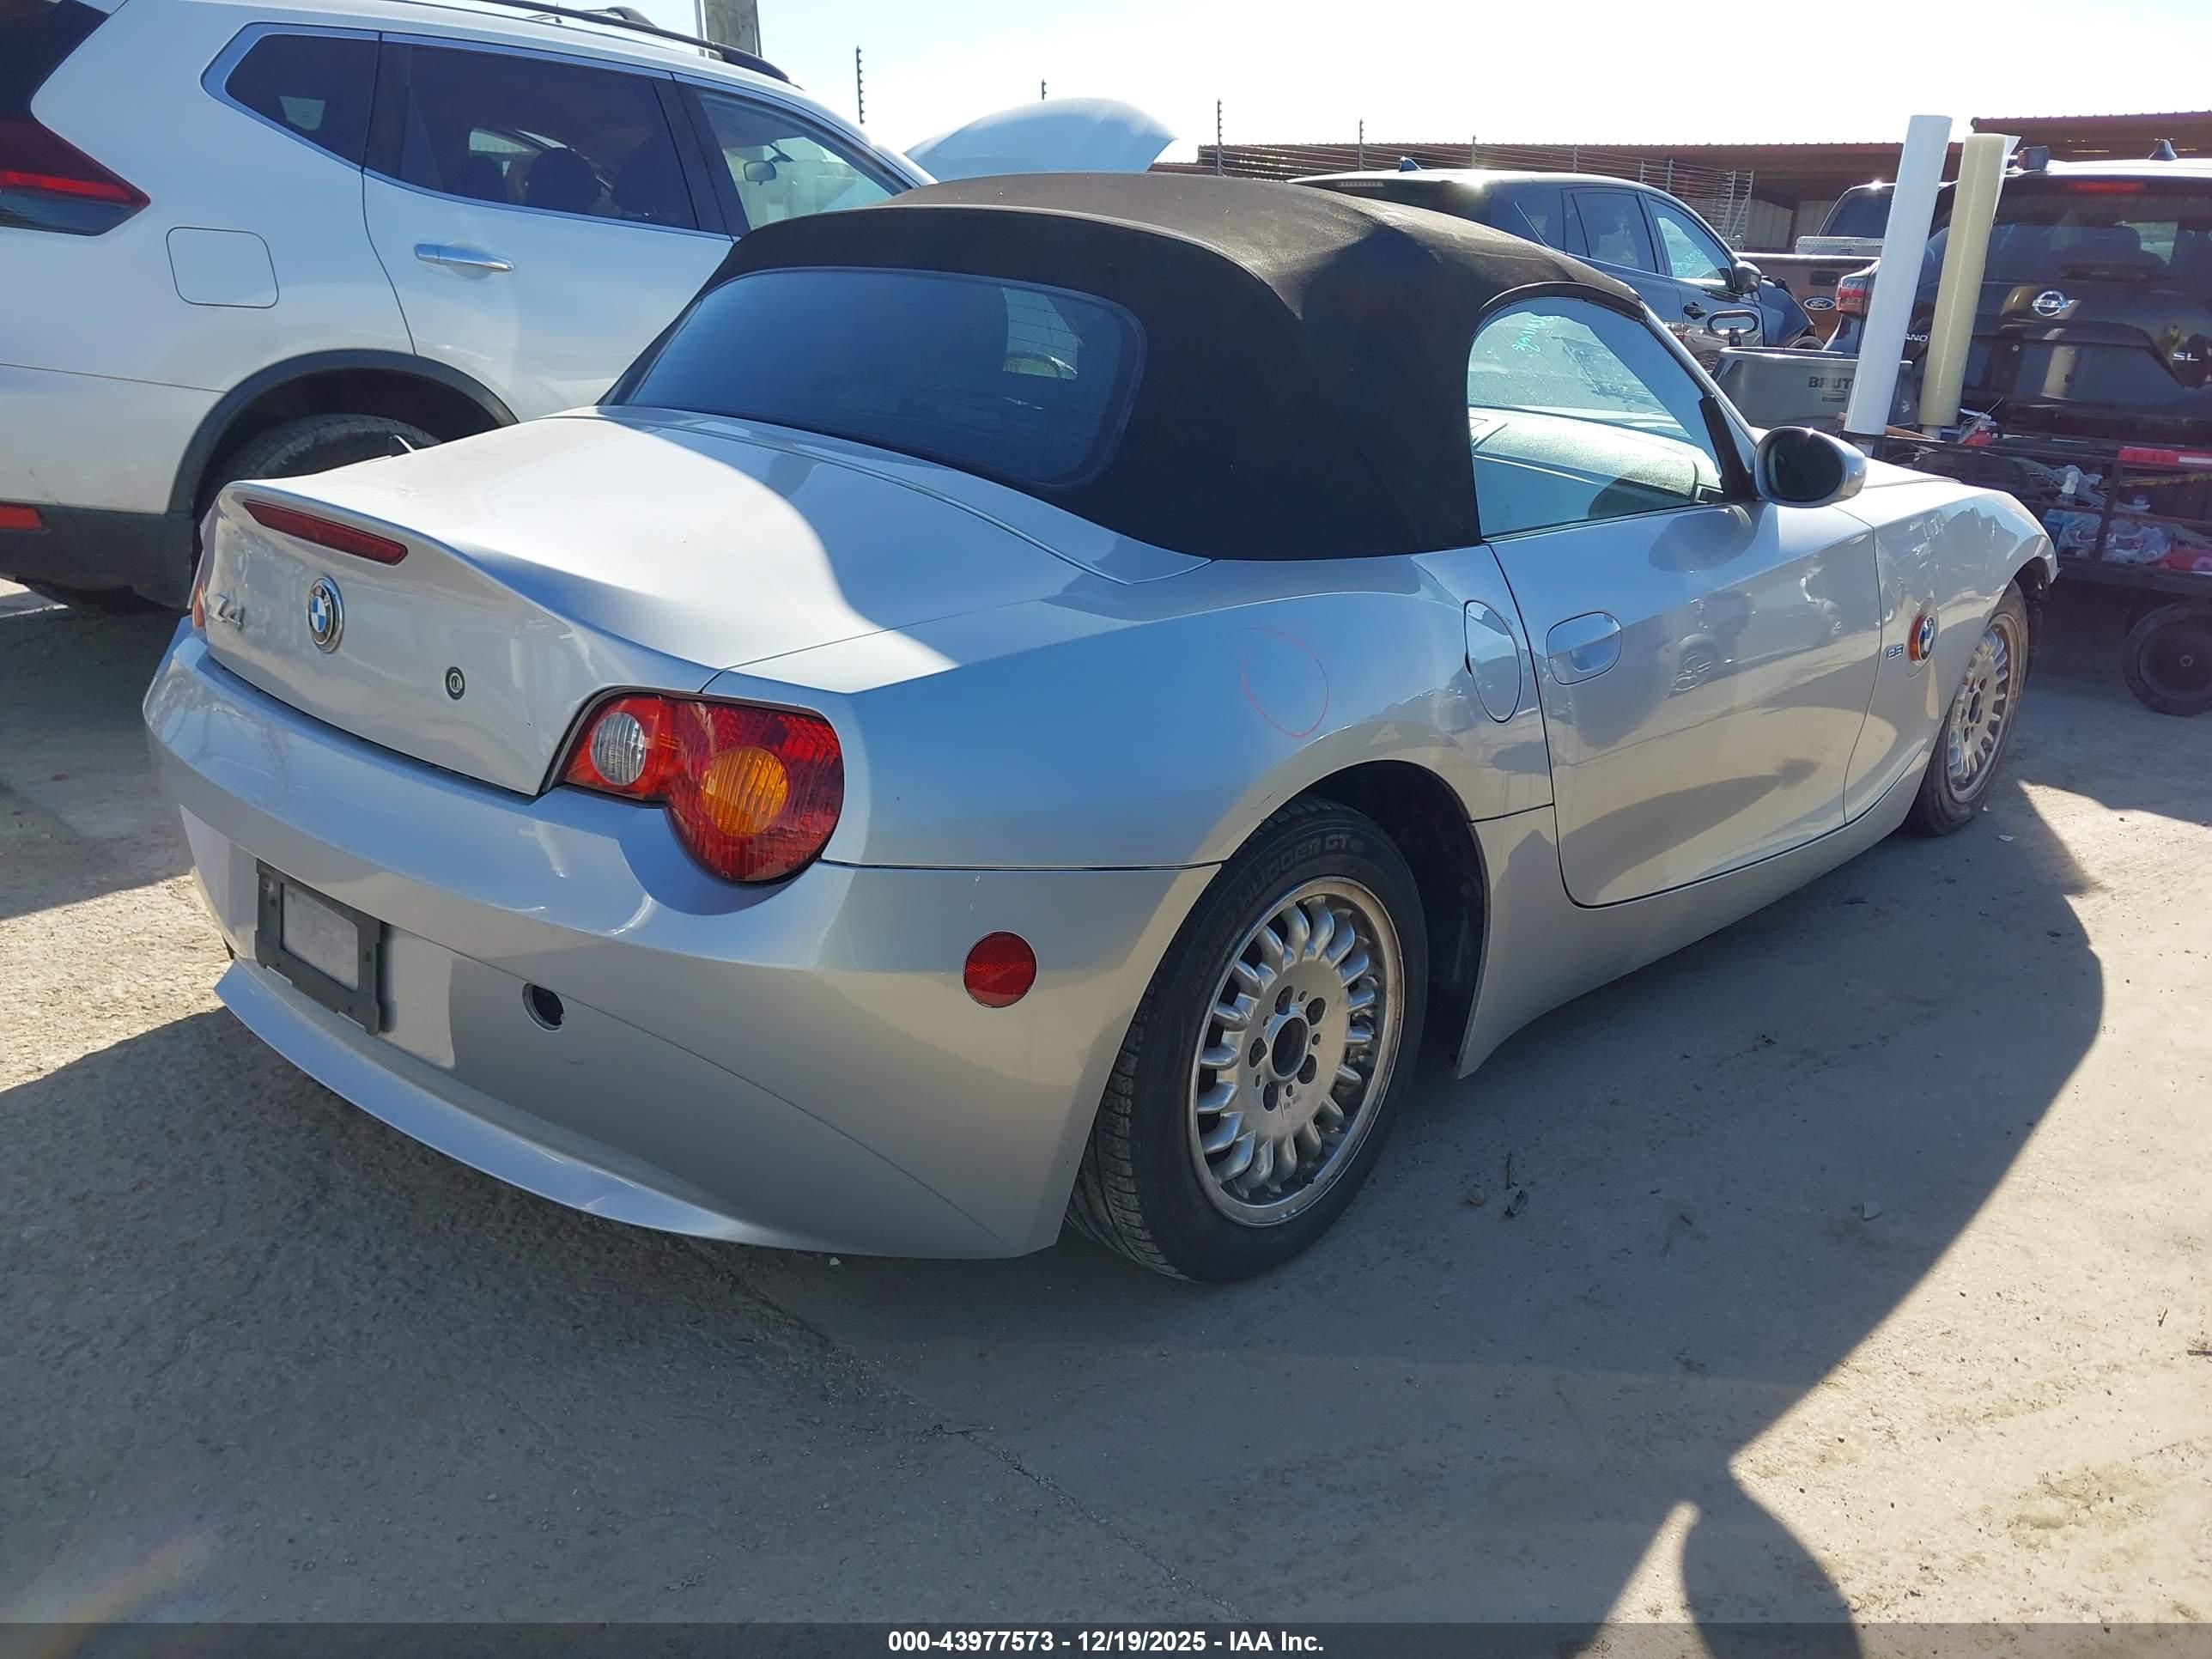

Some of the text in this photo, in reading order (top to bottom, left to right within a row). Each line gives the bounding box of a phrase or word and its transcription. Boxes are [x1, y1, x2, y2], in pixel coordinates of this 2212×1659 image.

[1809, 299, 1828, 308] Ford
[2172, 352, 2200, 361] SL
[210, 592, 246, 632] Z4
[1323, 832, 1352, 853] GT
